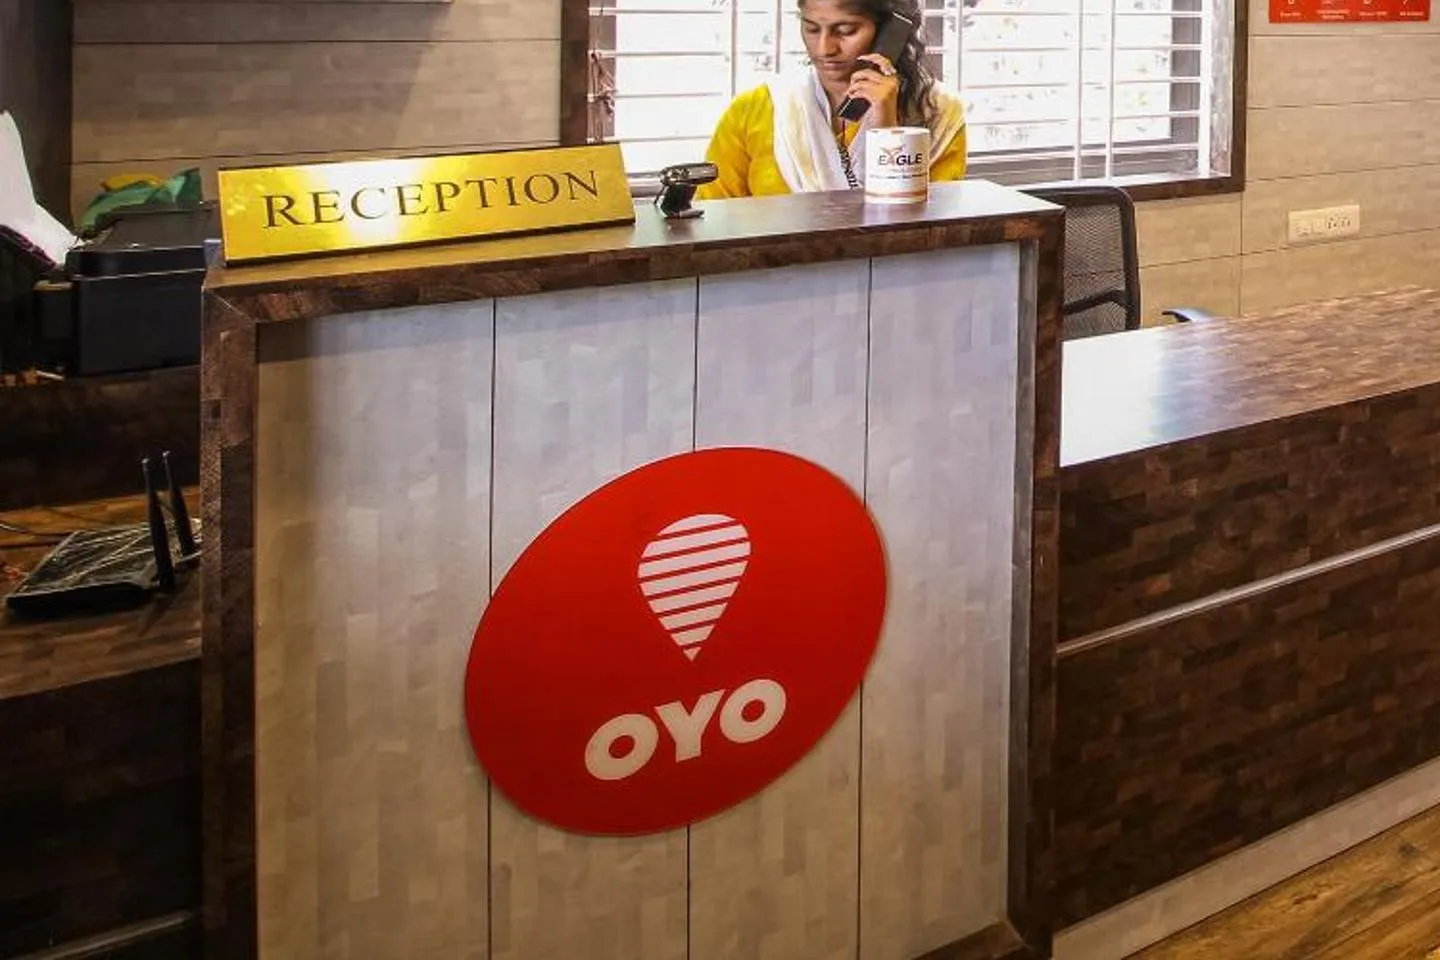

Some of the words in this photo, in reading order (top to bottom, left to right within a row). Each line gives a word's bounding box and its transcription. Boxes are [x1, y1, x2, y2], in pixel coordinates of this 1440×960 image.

[878, 152, 923, 166] EAGLE
[262, 170, 600, 229] RECEPTION
[584, 678, 787, 781] OYO
